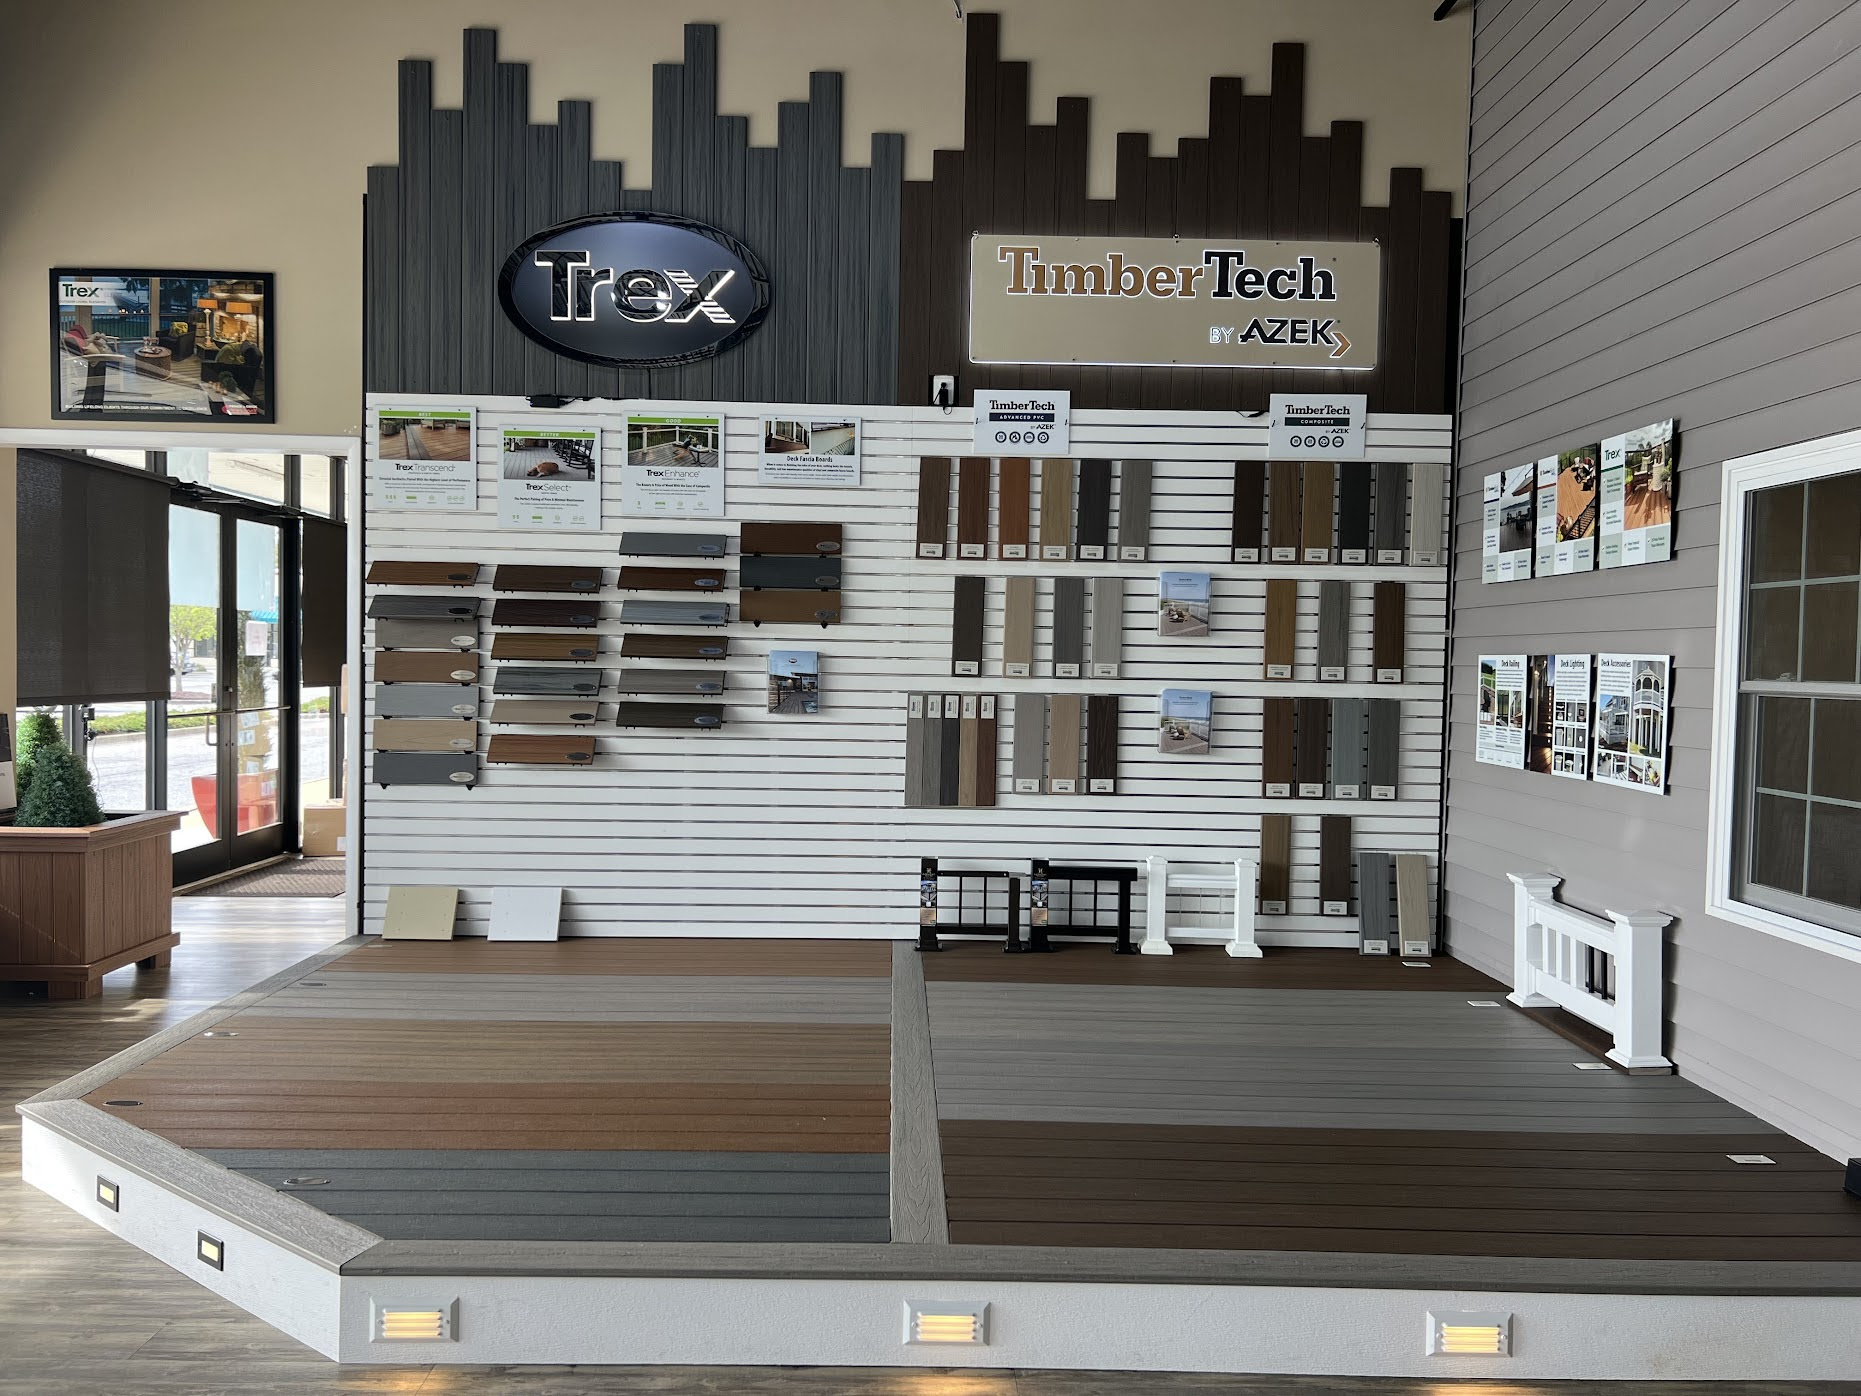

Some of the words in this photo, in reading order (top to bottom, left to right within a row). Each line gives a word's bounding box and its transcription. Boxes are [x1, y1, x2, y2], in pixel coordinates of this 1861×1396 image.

[997, 245, 1337, 301] TimberTech
[62, 283, 100, 298] Trex
[534, 250, 736, 324] Trex
[1209, 326, 1235, 344] BY
[1238, 317, 1336, 346] AZEK
[989, 399, 1055, 411] TimberTech
[1285, 404, 1351, 415] TimberTech
[1604, 448, 1621, 461] Trex
